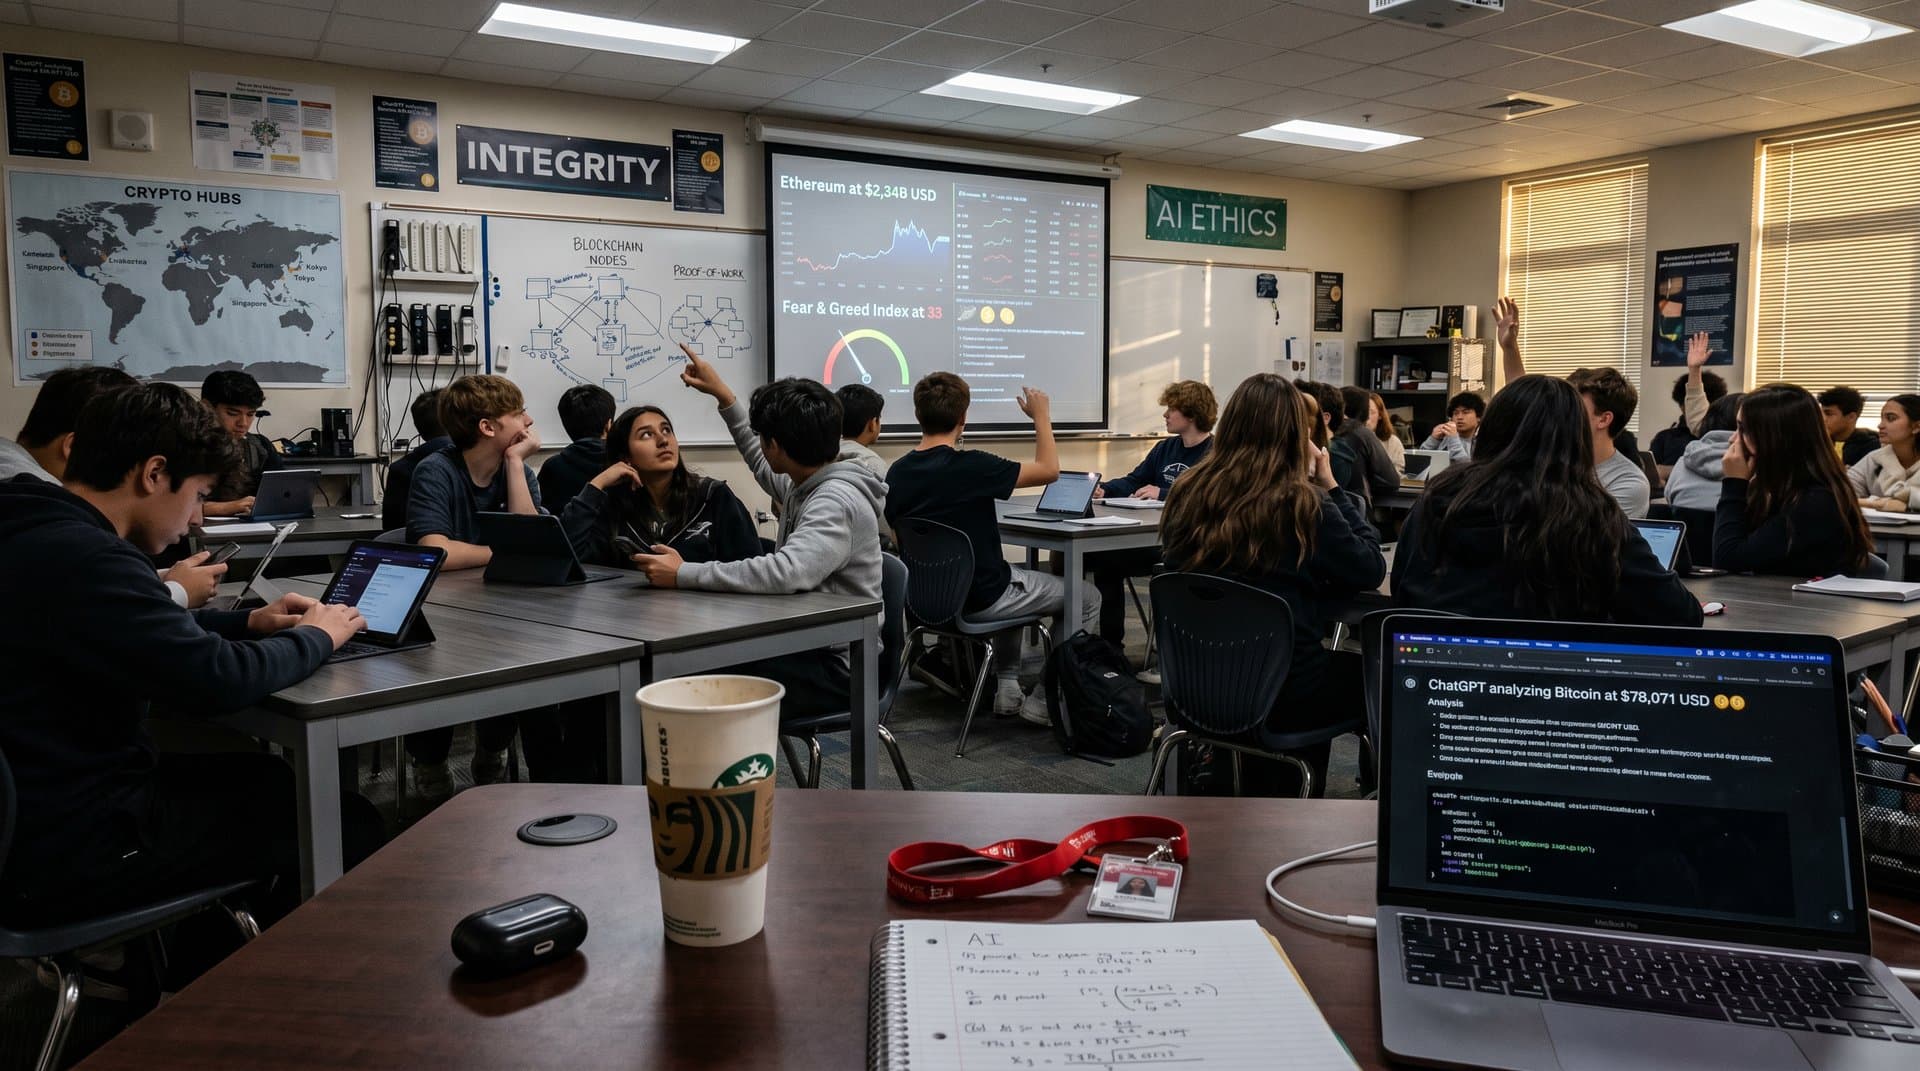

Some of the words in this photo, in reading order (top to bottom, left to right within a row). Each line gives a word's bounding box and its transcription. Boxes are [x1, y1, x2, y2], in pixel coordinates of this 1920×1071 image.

[467, 140, 661, 186] INTEGRITY
[124, 185, 192, 202] CRYPTO
[197, 191, 242, 205] HUBS
[780, 175, 846, 194] Ethereum
[849, 183, 862, 195] at
[911, 188, 936, 202] USD
[1156, 199, 1182, 229] AI
[1191, 203, 1277, 237] ETHICS
[573, 237, 643, 253] BLOCKCHAIN
[26, 263, 65, 272] Singapore
[589, 255, 628, 267] NODES
[294, 274, 315, 283] Tokyo
[673, 264, 745, 279] PROOF-OF-WORK
[231, 300, 267, 308] Singapore
[782, 300, 813, 314] Fear
[816, 301, 826, 315] &
[829, 302, 870, 316] Greed
[873, 303, 909, 318] Index
[912, 306, 925, 319] at
[927, 306, 943, 320] 33
[1428, 679, 1486, 694] ChatGPT
[1489, 683, 1552, 700] analyzing
[1554, 686, 1601, 701] Bitcoin
[1604, 691, 1618, 702] at
[1620, 690, 1676, 705] $78,071
[1679, 694, 1710, 707] USD
[1428, 698, 1464, 709] Analysis
[967, 932, 1004, 946] AI
